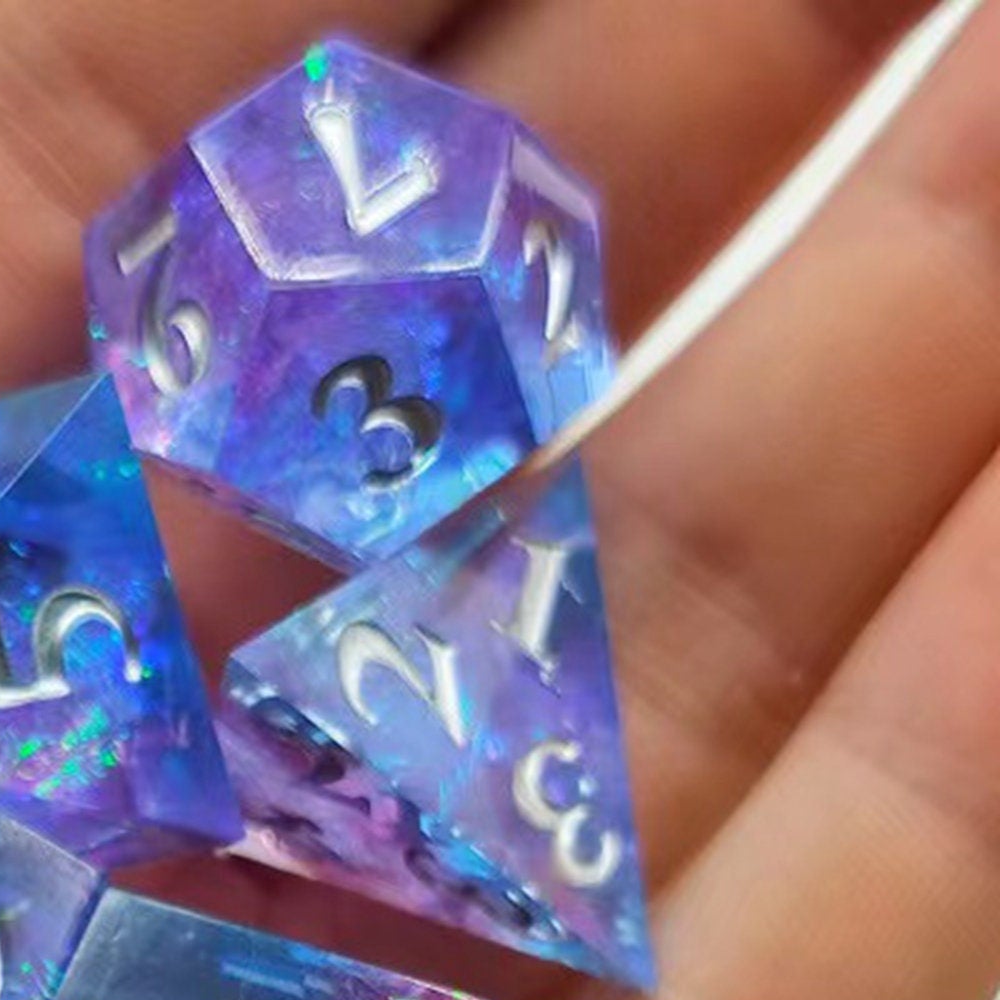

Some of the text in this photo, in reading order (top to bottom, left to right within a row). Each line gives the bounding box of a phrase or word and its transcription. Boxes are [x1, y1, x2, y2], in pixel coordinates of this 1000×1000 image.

[304, 100, 438, 237] 7
[308, 355, 439, 493] 3
[489, 533, 584, 692] 1
[336, 620, 467, 750] 2
[513, 740, 622, 887] 3
